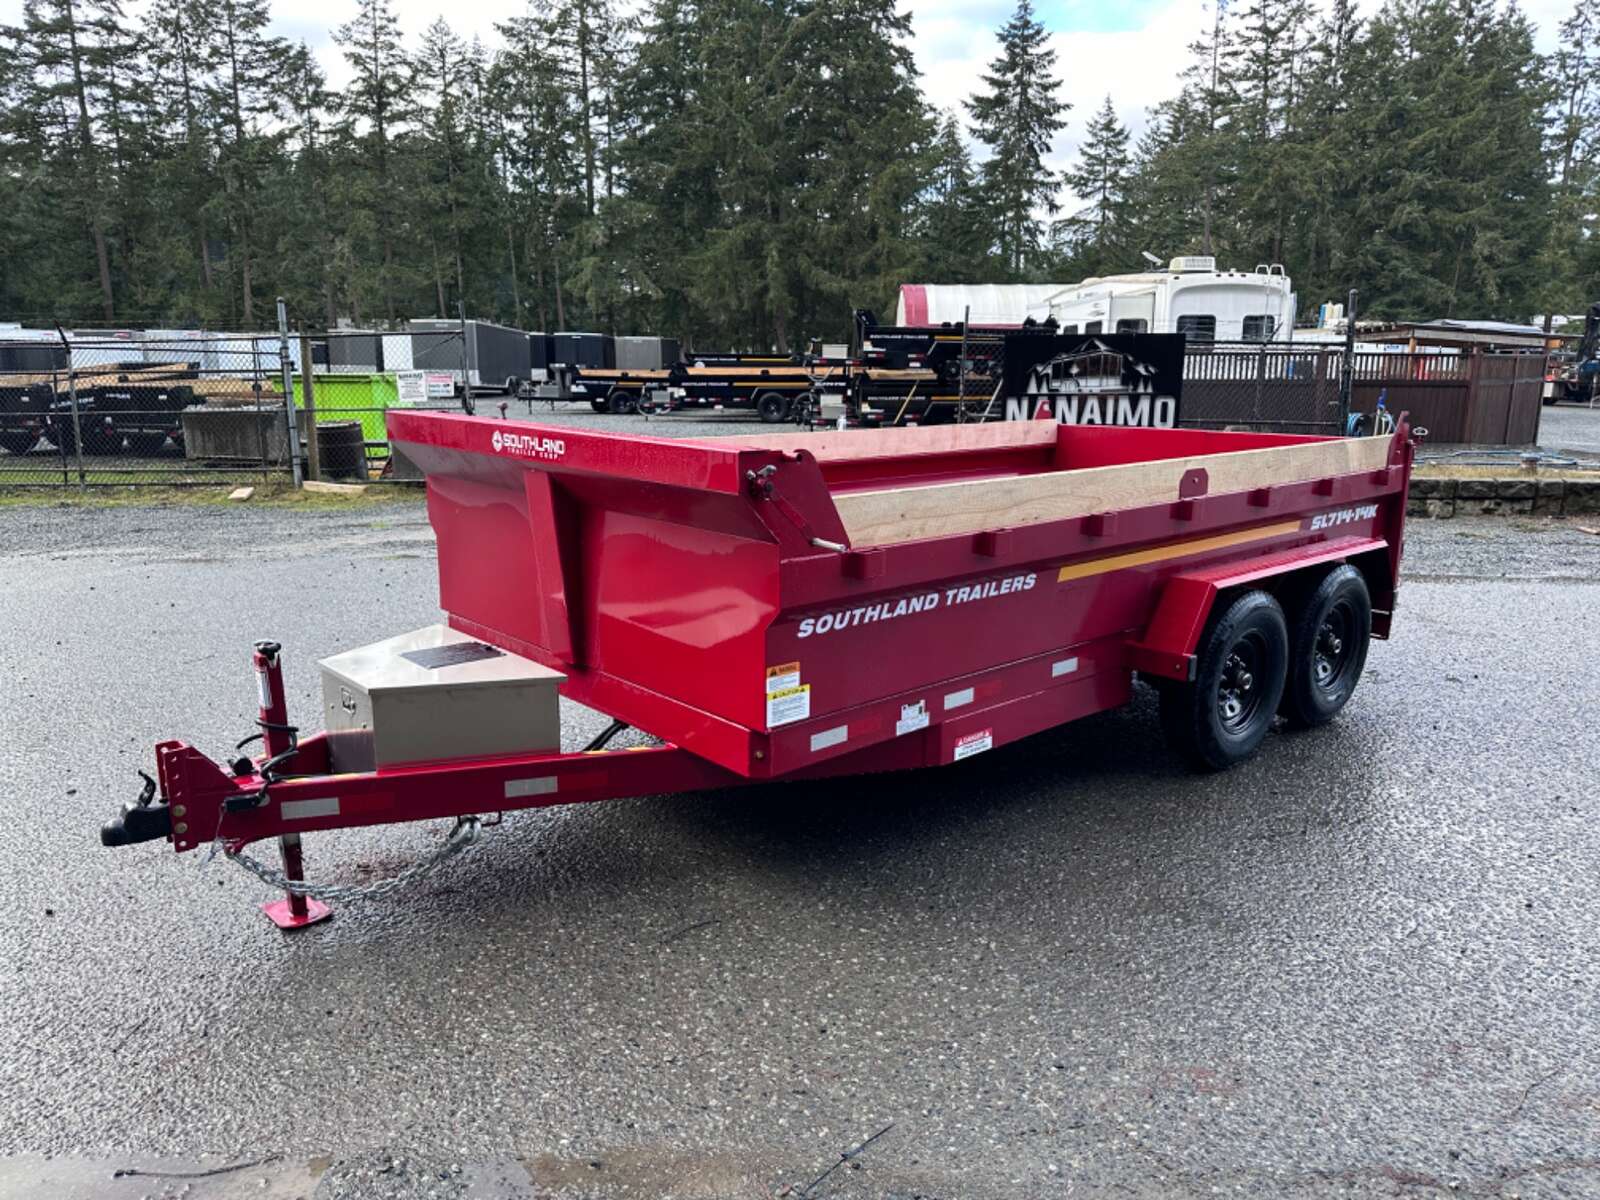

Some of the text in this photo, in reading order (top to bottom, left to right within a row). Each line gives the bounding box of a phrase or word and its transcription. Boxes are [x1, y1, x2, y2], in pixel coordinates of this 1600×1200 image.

[503, 433, 565, 455] SOUTHLAND
[1310, 504, 1379, 531] SL714-14K
[797, 573, 1038, 638] SOUTHLAND TRAILERS
